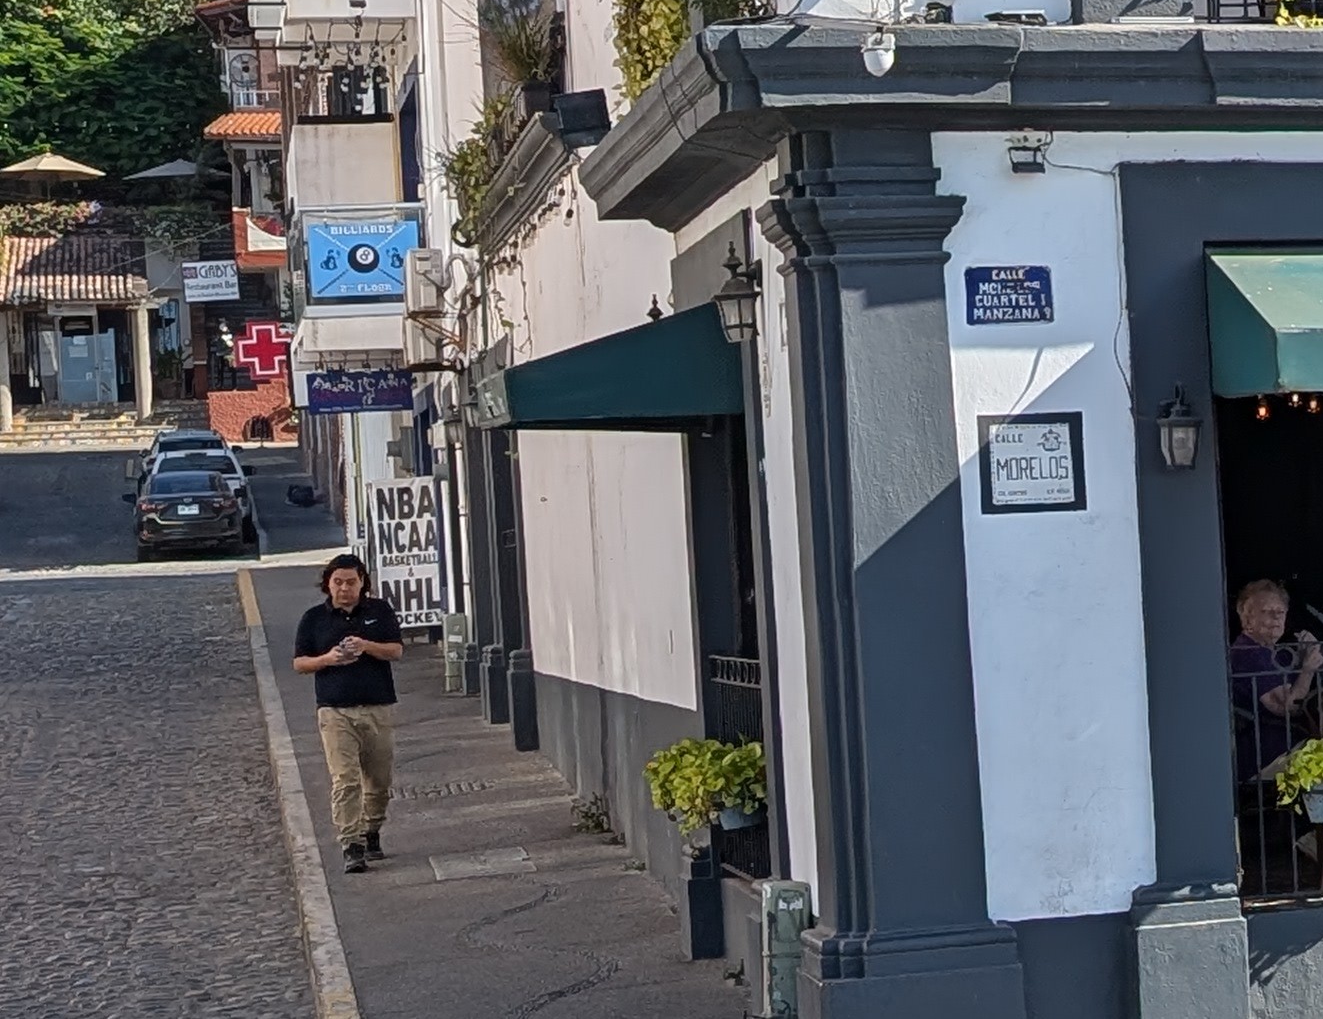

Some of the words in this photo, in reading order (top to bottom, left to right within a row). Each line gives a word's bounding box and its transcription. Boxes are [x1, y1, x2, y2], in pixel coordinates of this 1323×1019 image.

[330, 224, 394, 235] BILLIARDS
[991, 269, 1026, 281] CALLE
[974, 293, 1036, 307] CUARTEL
[973, 307, 1040, 321] MANZANA
[995, 434, 1024, 444] CALLE
[996, 455, 1069, 482] MORELOS
[376, 485, 436, 521] NBA
[378, 520, 438, 555] NCAA
[382, 577, 441, 613] NHL
[397, 610, 443, 625] OCKEY
